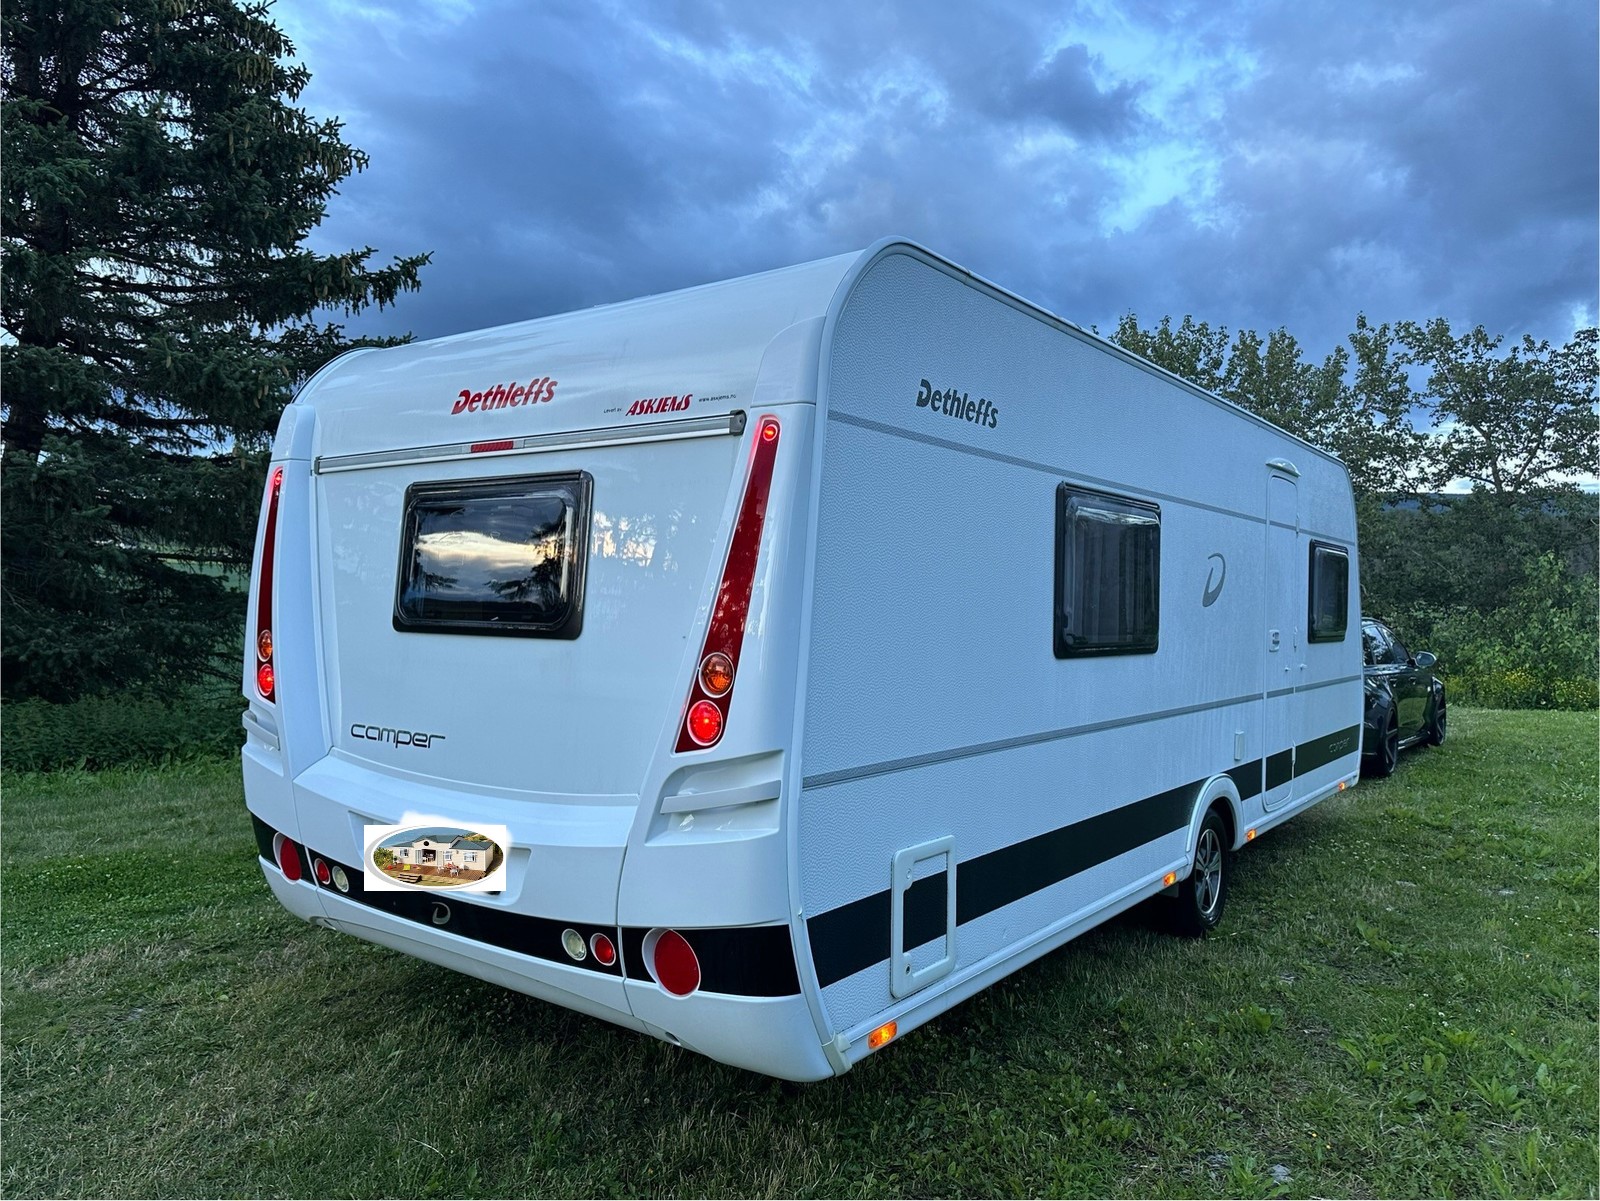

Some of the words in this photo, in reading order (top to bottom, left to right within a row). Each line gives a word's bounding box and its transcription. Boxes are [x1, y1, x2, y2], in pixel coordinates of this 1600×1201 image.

[451, 376, 558, 415] Dethleffs
[916, 378, 999, 429] Dethleffs
[350, 723, 446, 749] camper
